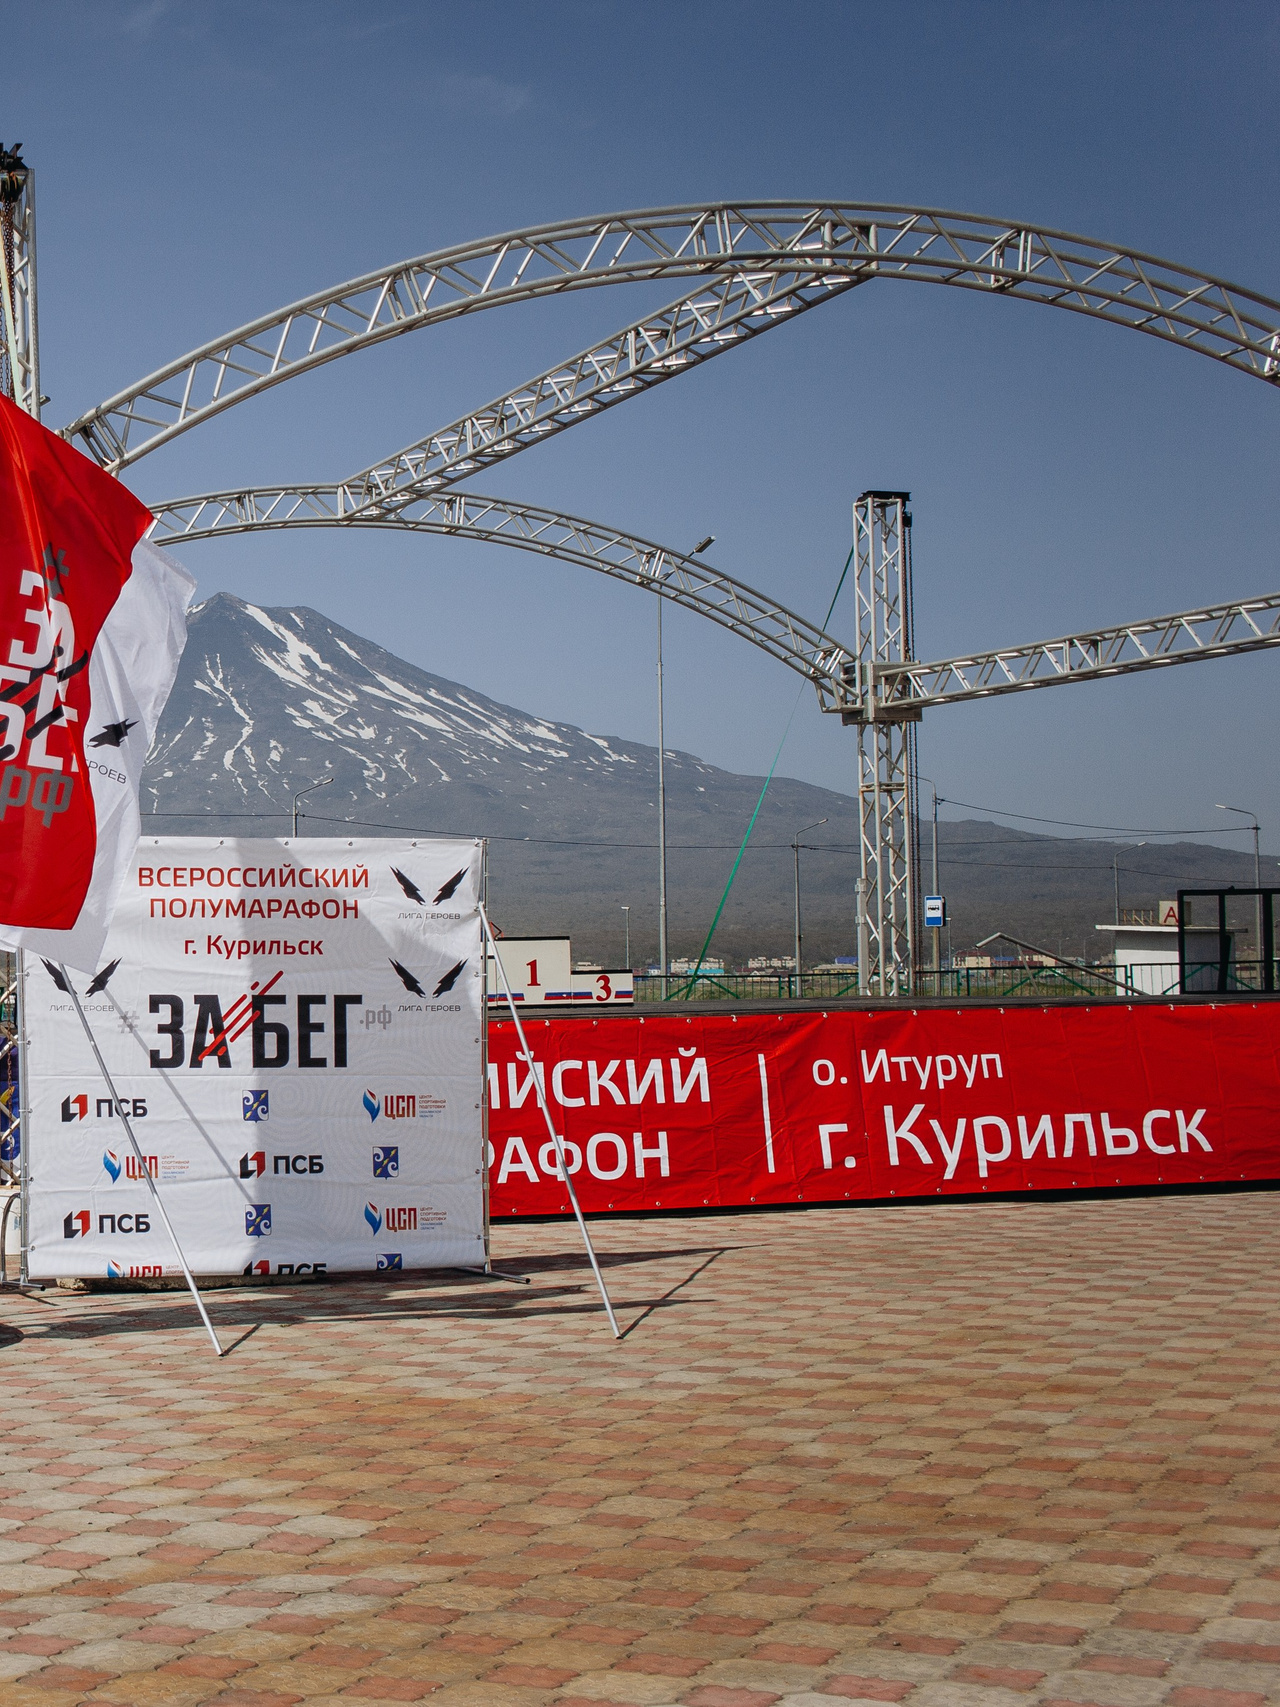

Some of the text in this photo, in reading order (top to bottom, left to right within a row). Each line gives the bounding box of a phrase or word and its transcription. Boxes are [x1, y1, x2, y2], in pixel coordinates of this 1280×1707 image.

[138, 864, 369, 888] ВСЕРОССИЙСКИЙ
[150, 898, 359, 919] ПОЛУМАРАФОН
[184, 935, 324, 960] г. Курильск
[526, 959, 541, 986] 1
[596, 975, 612, 1002] 3
[812, 1049, 1003, 1090] о. Итуруп
[96, 1098, 148, 1118] ПСБ
[384, 1095, 416, 1120] ЦСП
[818, 1104, 1213, 1180] г. Курильск
[274, 1155, 324, 1175] ПСБ
[98, 1214, 151, 1233] ПСБ
[386, 1208, 417, 1232] ЦСП
